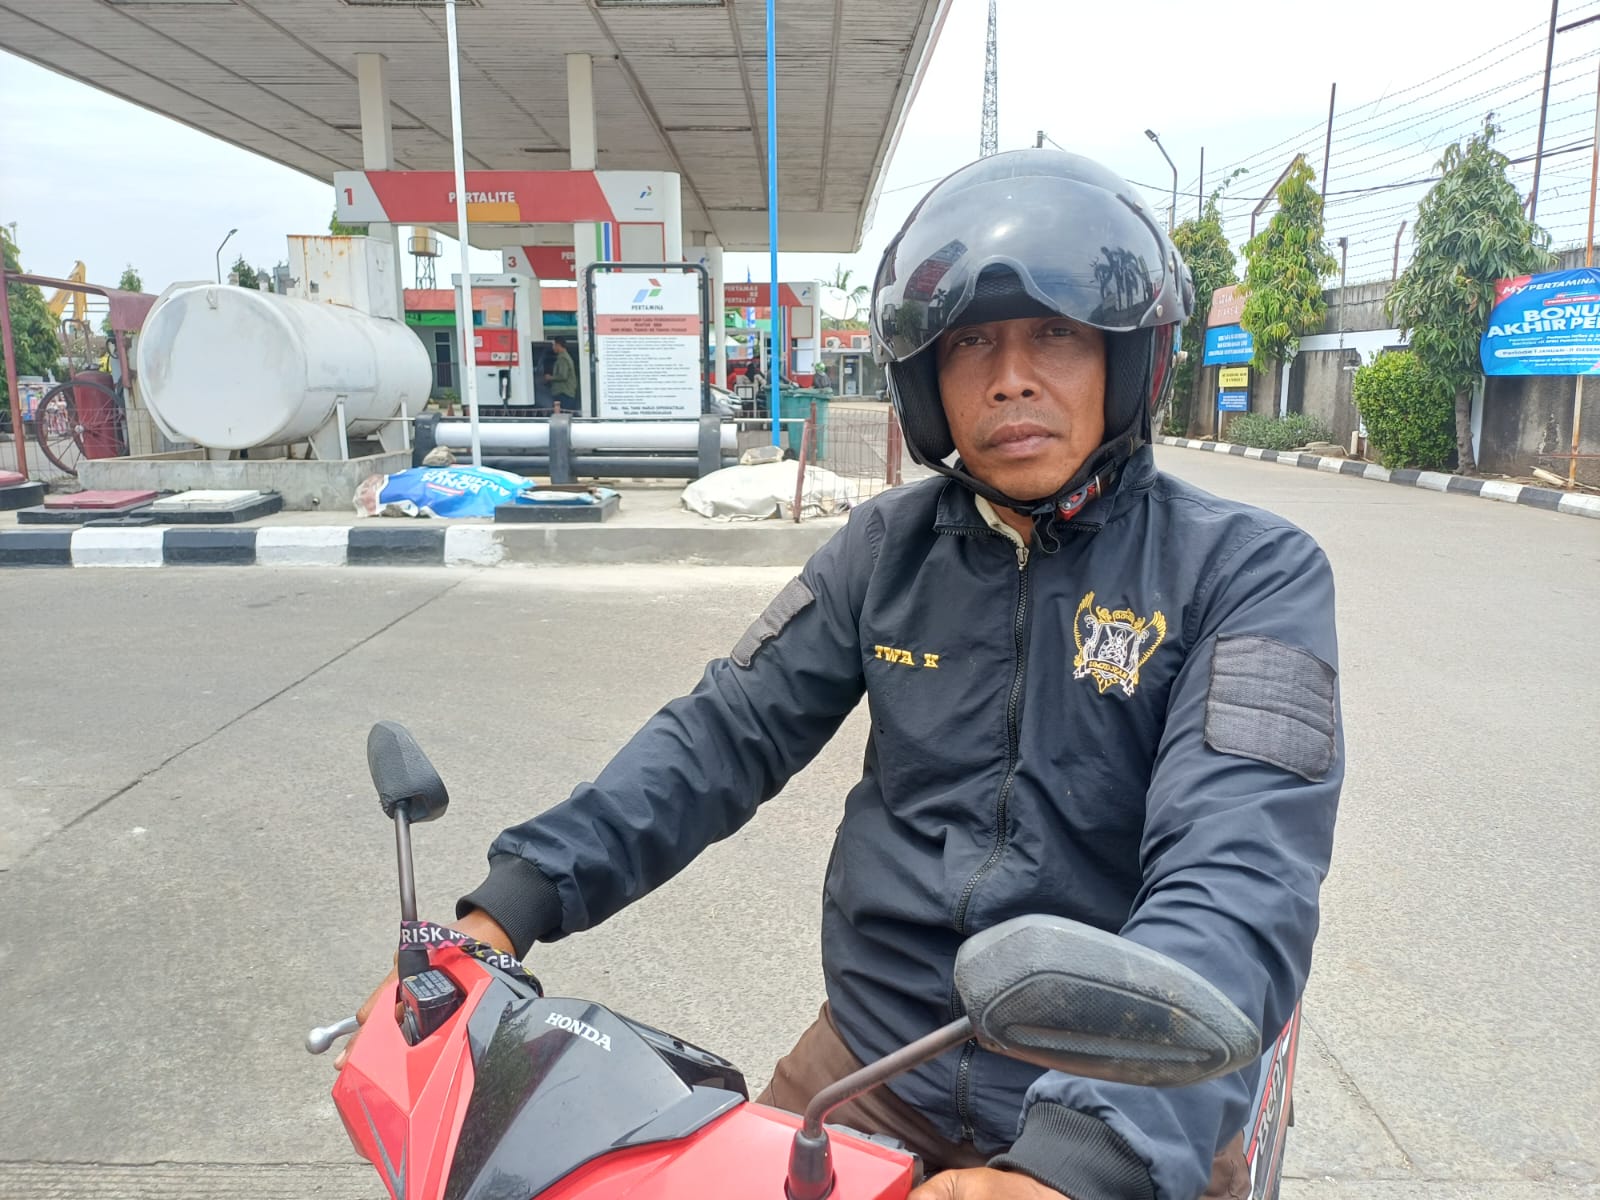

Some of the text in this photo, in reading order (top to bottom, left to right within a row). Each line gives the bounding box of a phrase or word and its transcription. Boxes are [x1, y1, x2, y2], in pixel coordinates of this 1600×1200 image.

[344, 188, 353, 206] 1
[448, 191, 516, 203] PRTALITE
[508, 256, 517, 268] 3
[1486, 318, 1567, 339] AKHIR
[923, 653, 940, 670] K
[402, 927, 444, 944] RISK
[544, 1012, 613, 1052] HONDA
